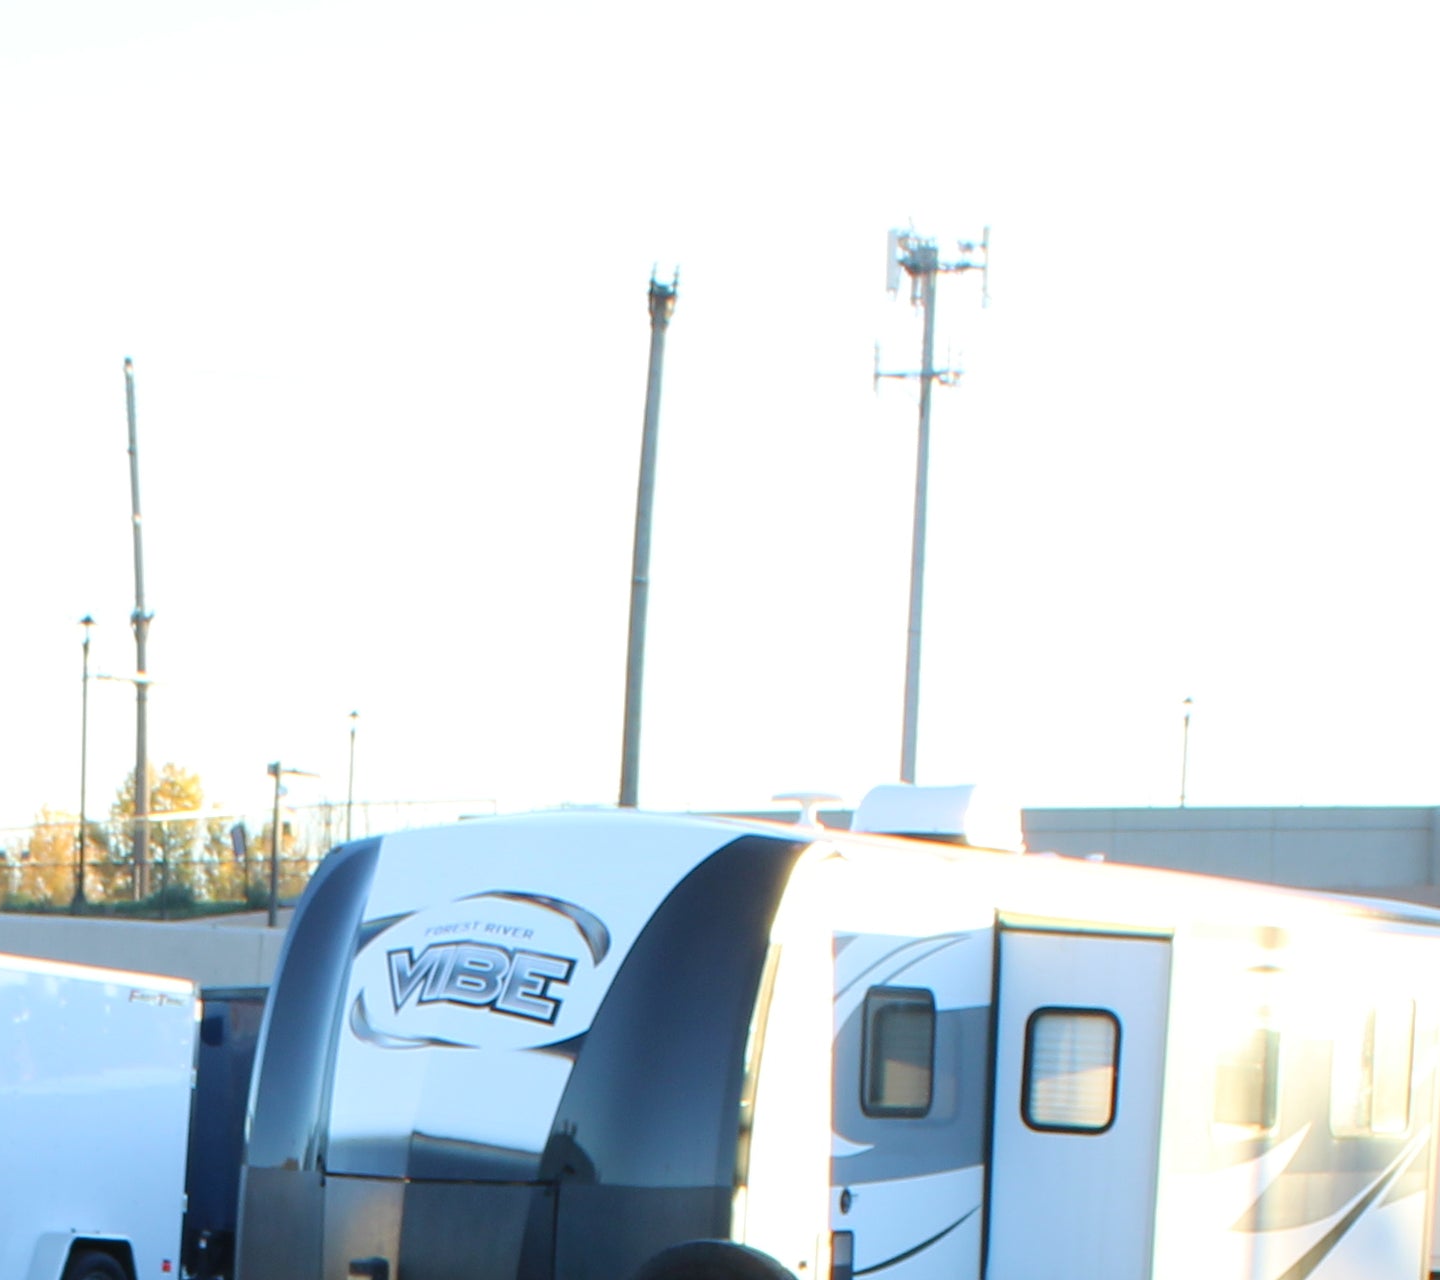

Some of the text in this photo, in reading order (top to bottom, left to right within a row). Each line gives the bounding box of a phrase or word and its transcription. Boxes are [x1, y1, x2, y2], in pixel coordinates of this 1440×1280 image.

[424, 921, 535, 940] FOREST RIVER
[386, 940, 579, 1026] VIBE
